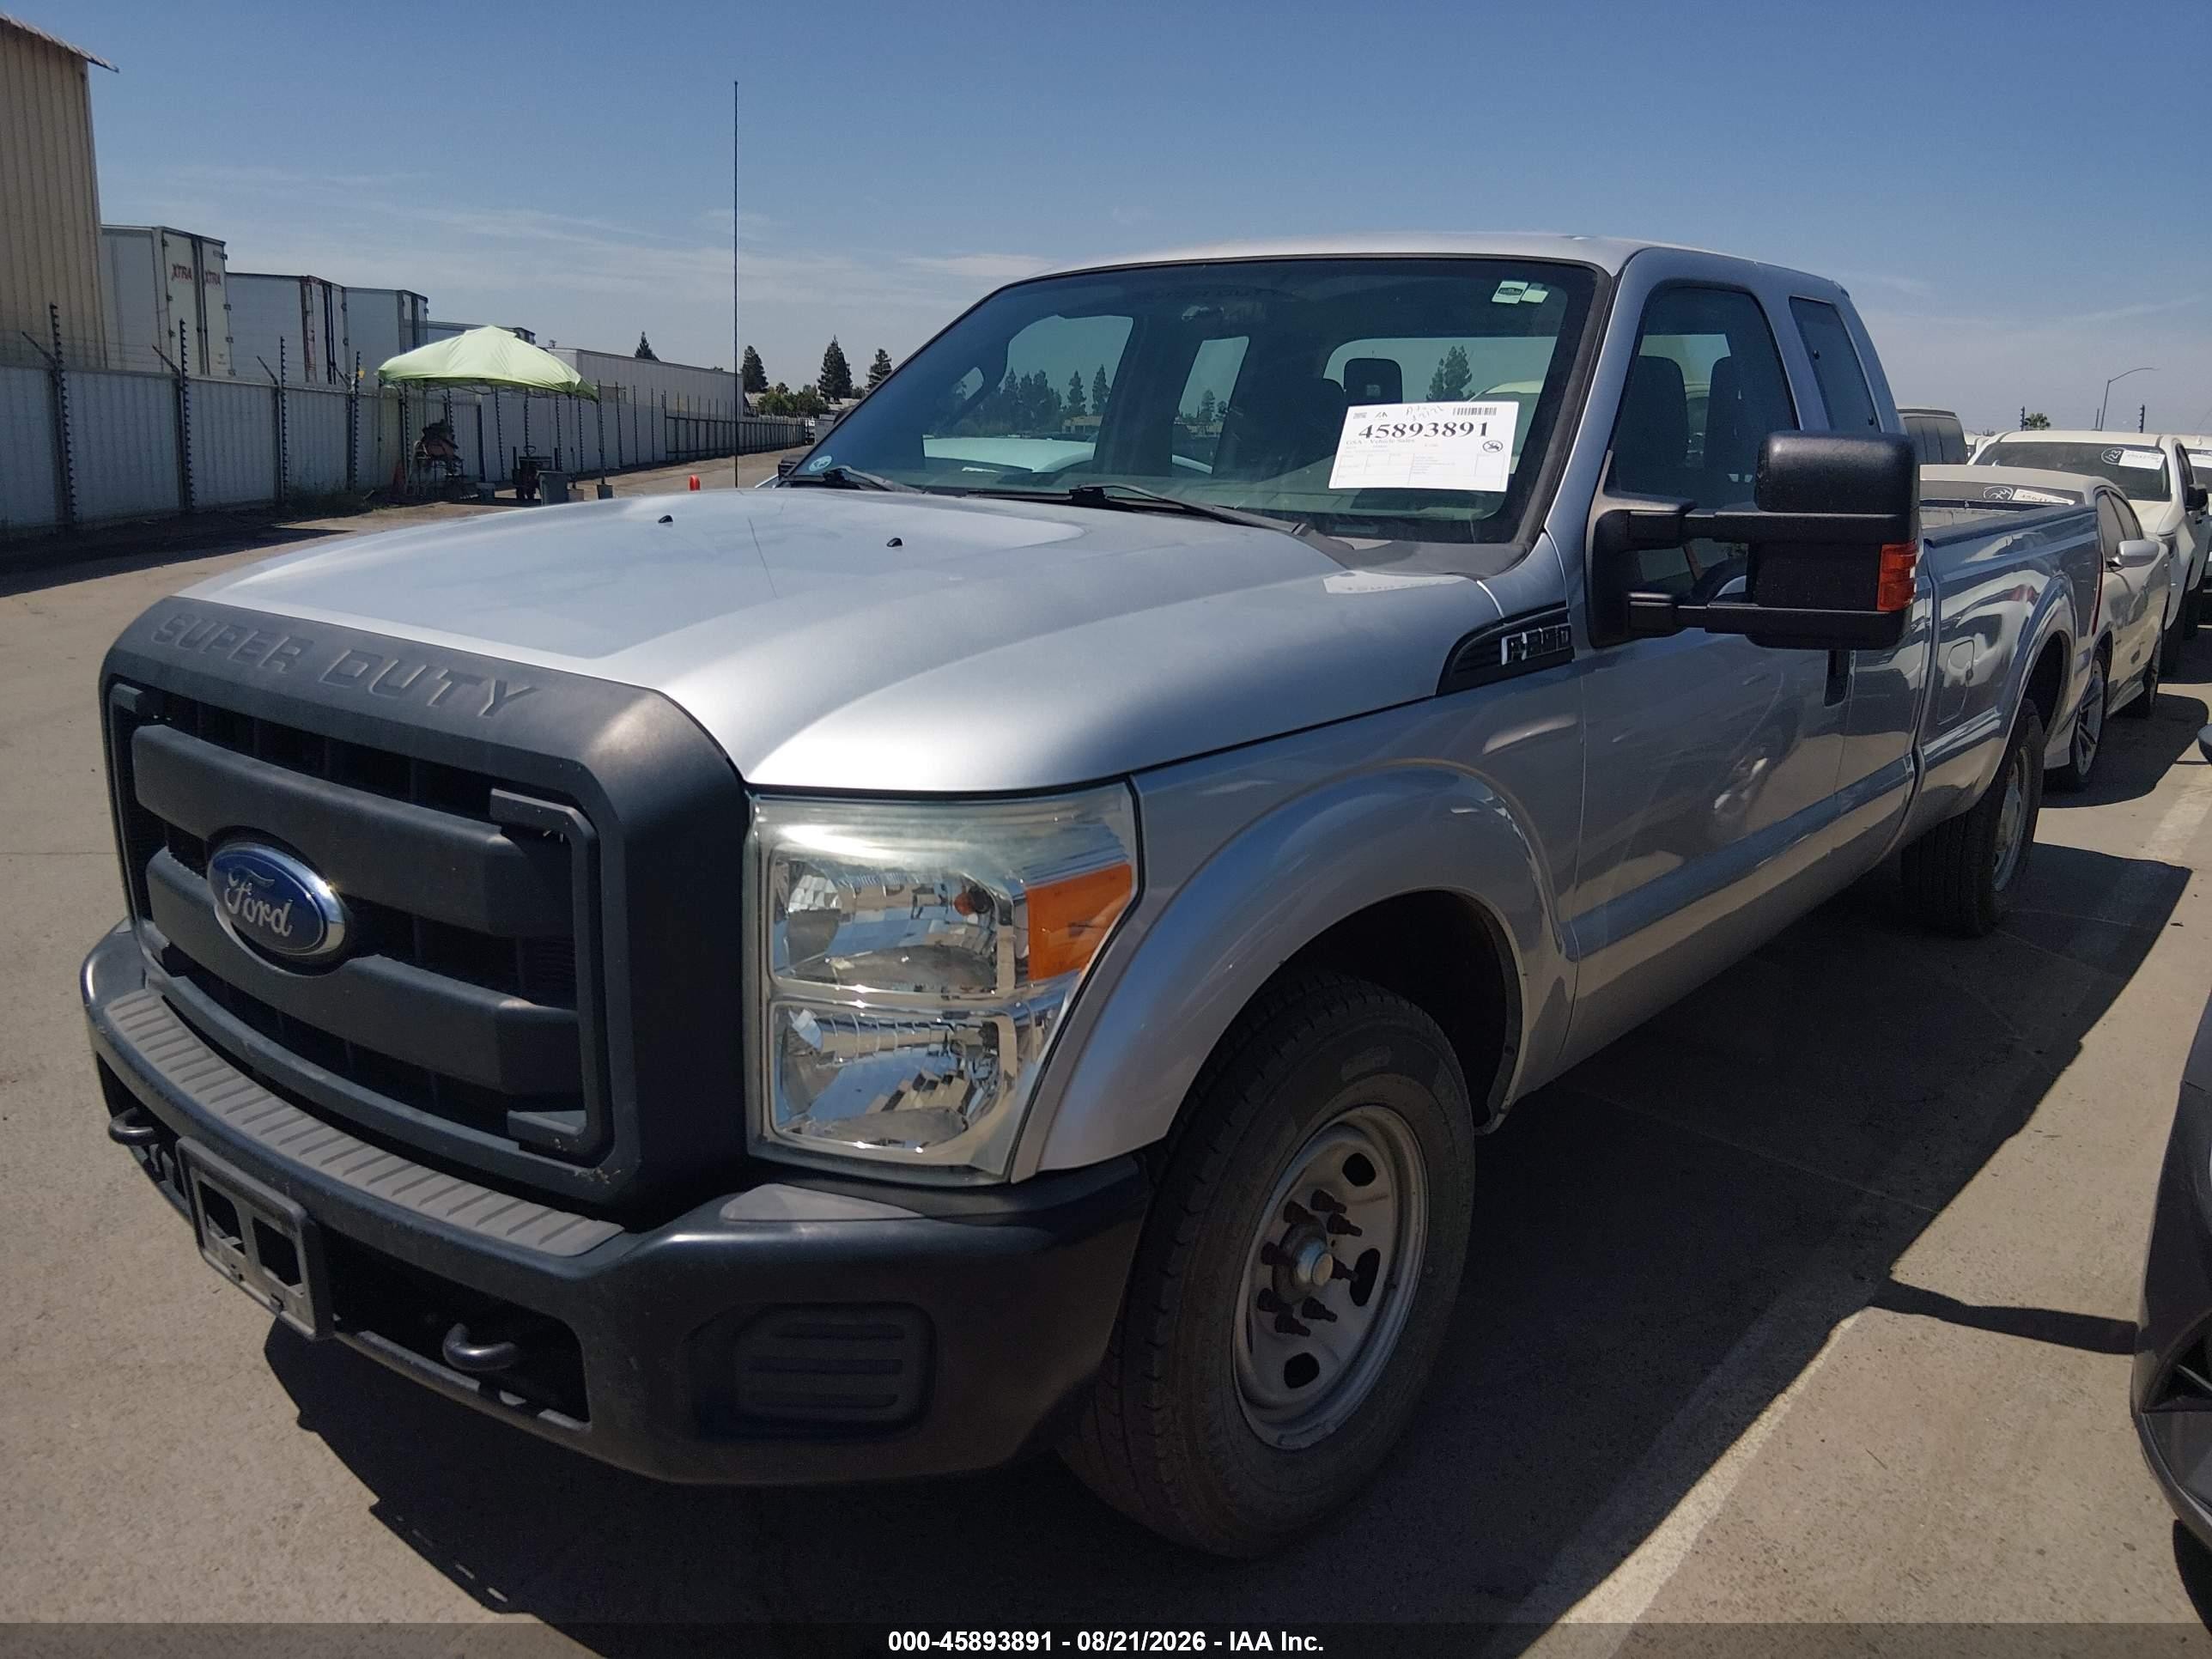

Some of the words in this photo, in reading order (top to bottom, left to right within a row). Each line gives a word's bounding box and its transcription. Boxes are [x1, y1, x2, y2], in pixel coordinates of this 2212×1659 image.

[1358, 422, 1488, 439] 45893891
[151, 614, 314, 673] SUPER
[319, 650, 538, 717] DUTY
[223, 868, 294, 938] Ford
